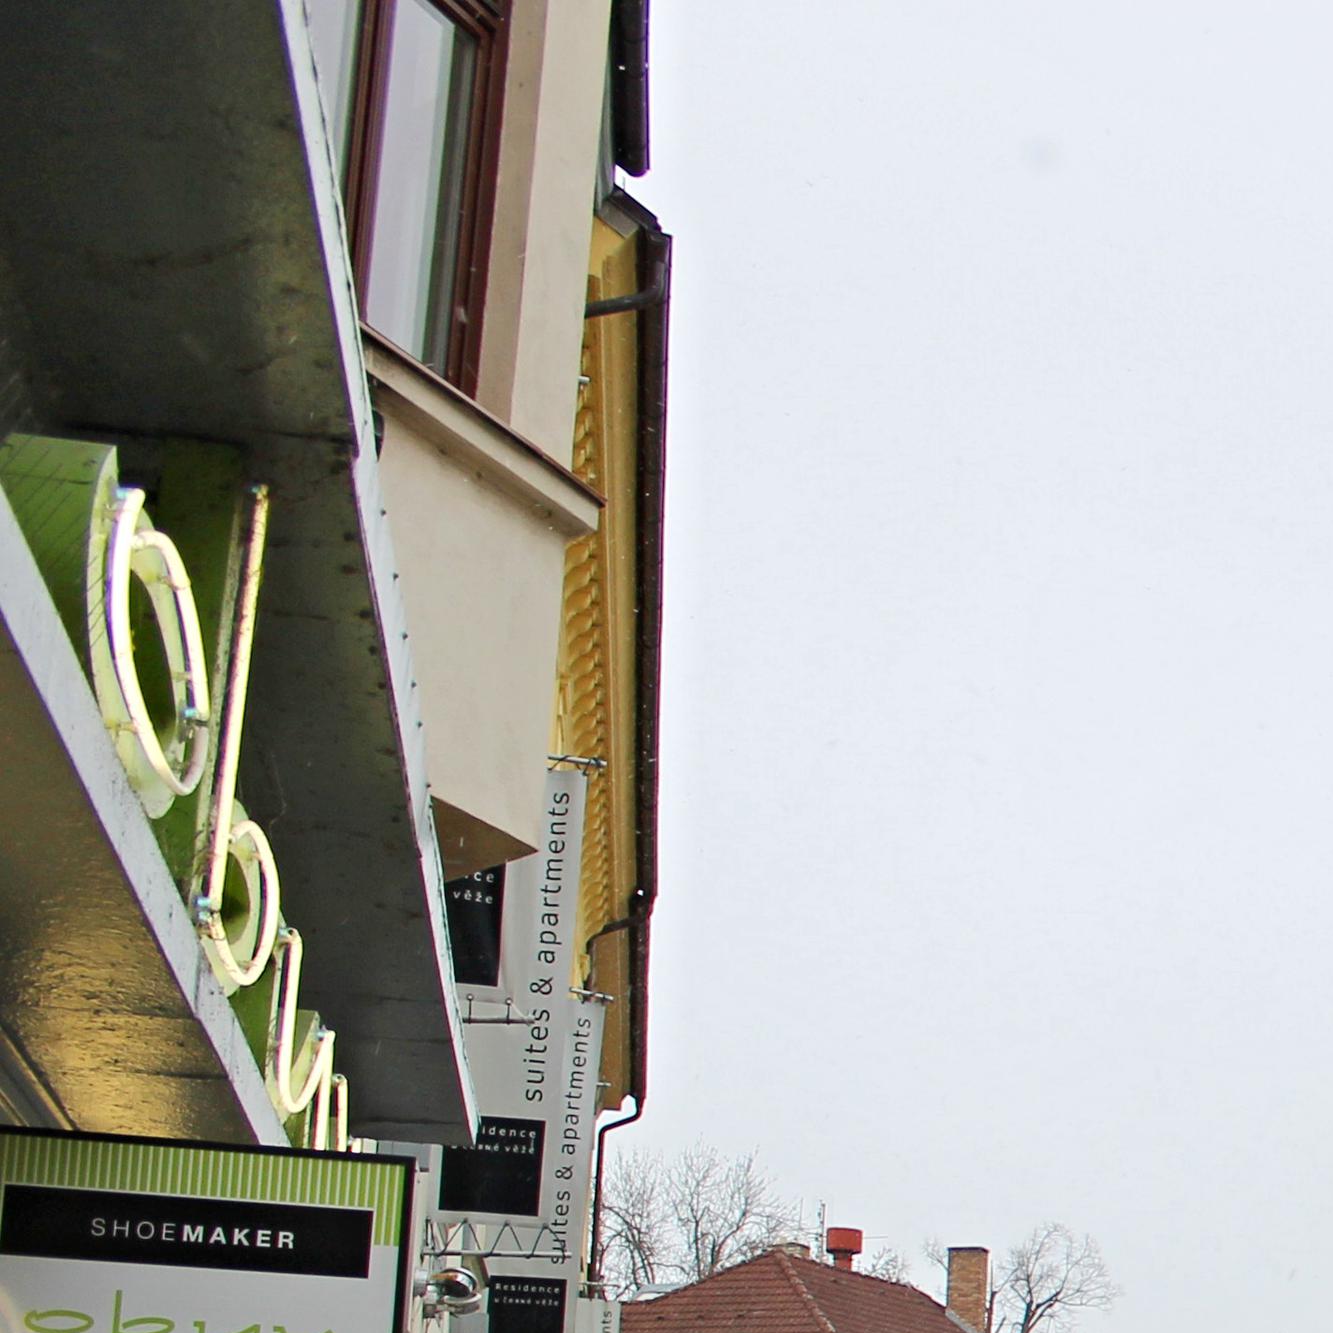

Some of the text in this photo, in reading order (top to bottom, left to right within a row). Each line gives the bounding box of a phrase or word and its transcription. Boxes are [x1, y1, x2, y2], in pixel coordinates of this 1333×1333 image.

[525, 791, 570, 1102] suites & apartments
[481, 1125, 537, 1139] idence
[551, 1017, 591, 1264] suites & apartments
[91, 1217, 295, 1249] SHOEMAKER
[495, 1283, 560, 1294] Residence
